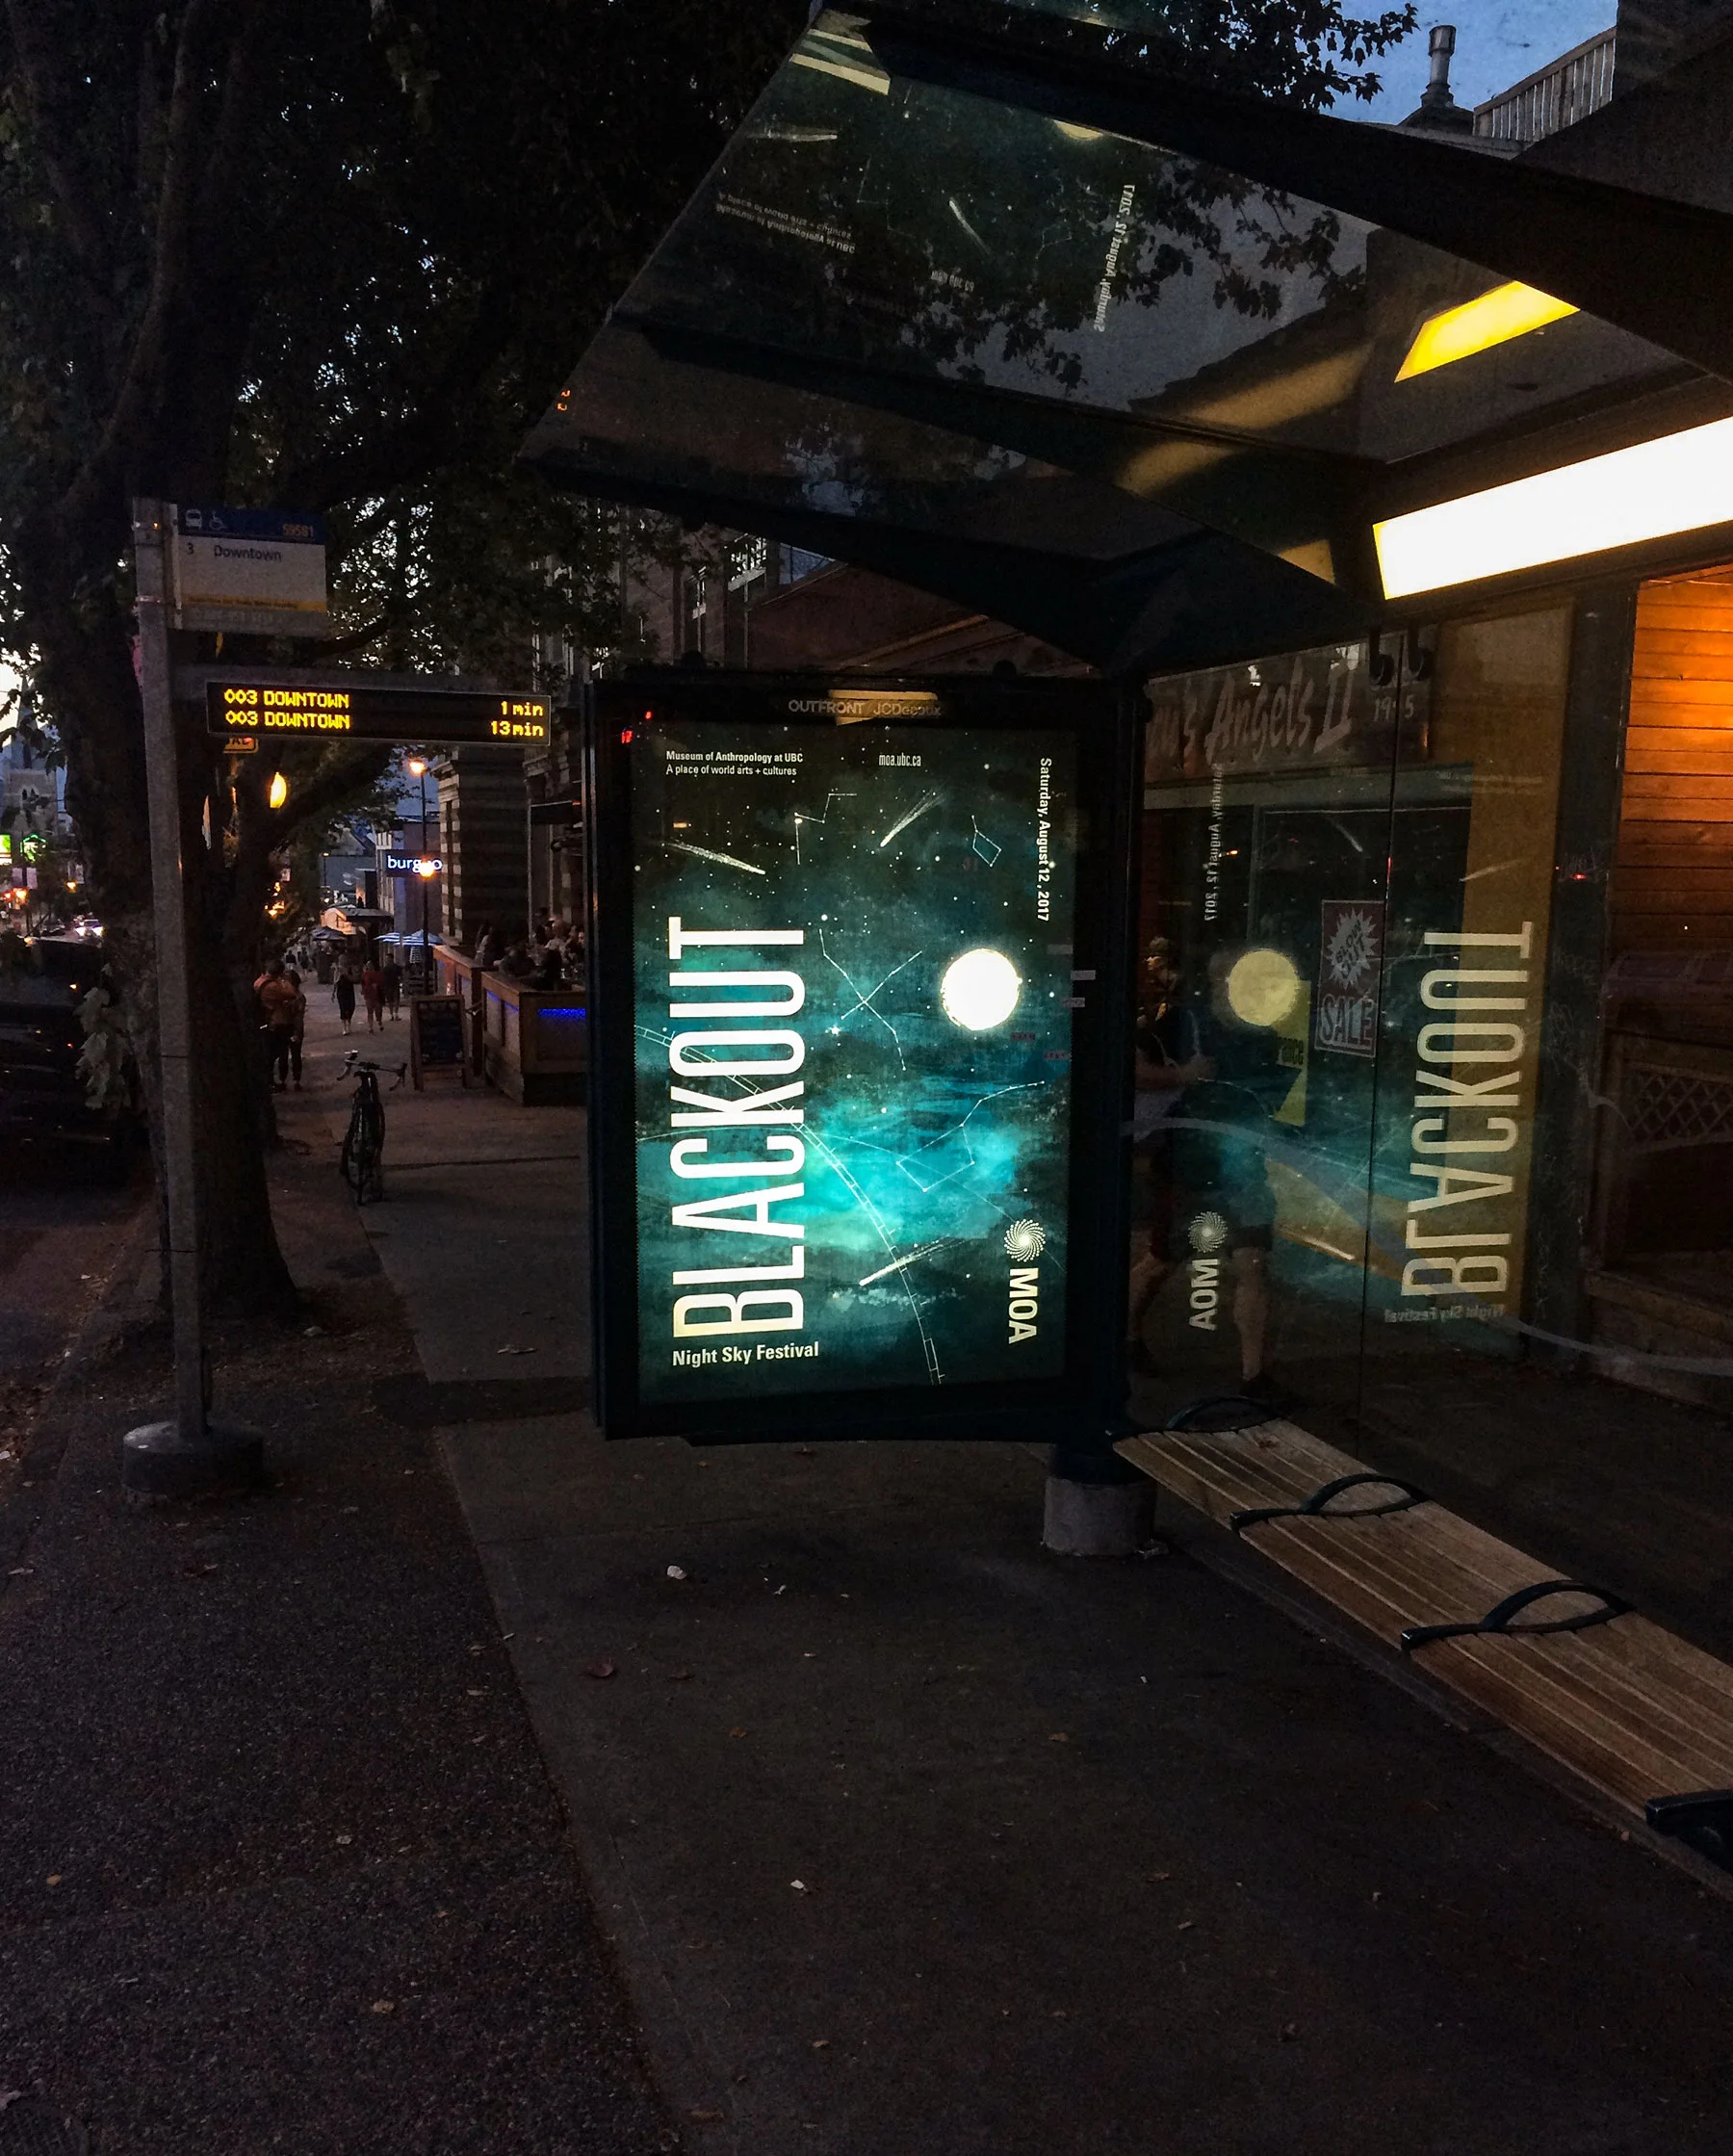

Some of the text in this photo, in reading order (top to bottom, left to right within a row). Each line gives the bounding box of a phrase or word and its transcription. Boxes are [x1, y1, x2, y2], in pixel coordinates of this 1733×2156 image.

[186, 542, 282, 562] 3 Downtown
[224, 688, 349, 709] 003 DOWNTOWN
[788, 699, 866, 716] OUTFRONT
[225, 711, 350, 730] 003 DOWNTOWN
[665, 750, 804, 765] Museum of Anthropology at UBC
[878, 752, 922, 767] moa.ubc.ca
[665, 764, 674, 775] A
[675, 765, 700, 776] place
[701, 765, 710, 774] of
[711, 765, 735, 775] world
[737, 766, 754, 775] arts
[763, 766, 797, 776] cultures
[1037, 758, 1052, 818] Saturday,
[1036, 819, 1051, 865] August
[387, 854, 443, 875] burgo
[1037, 891, 1050, 922] 2017
[1319, 993, 1376, 1051] SALE
[668, 916, 806, 1338] BLACKOUT
[1008, 1267, 1039, 1344] MOA
[672, 1341, 819, 1368] Night Sky Festival
